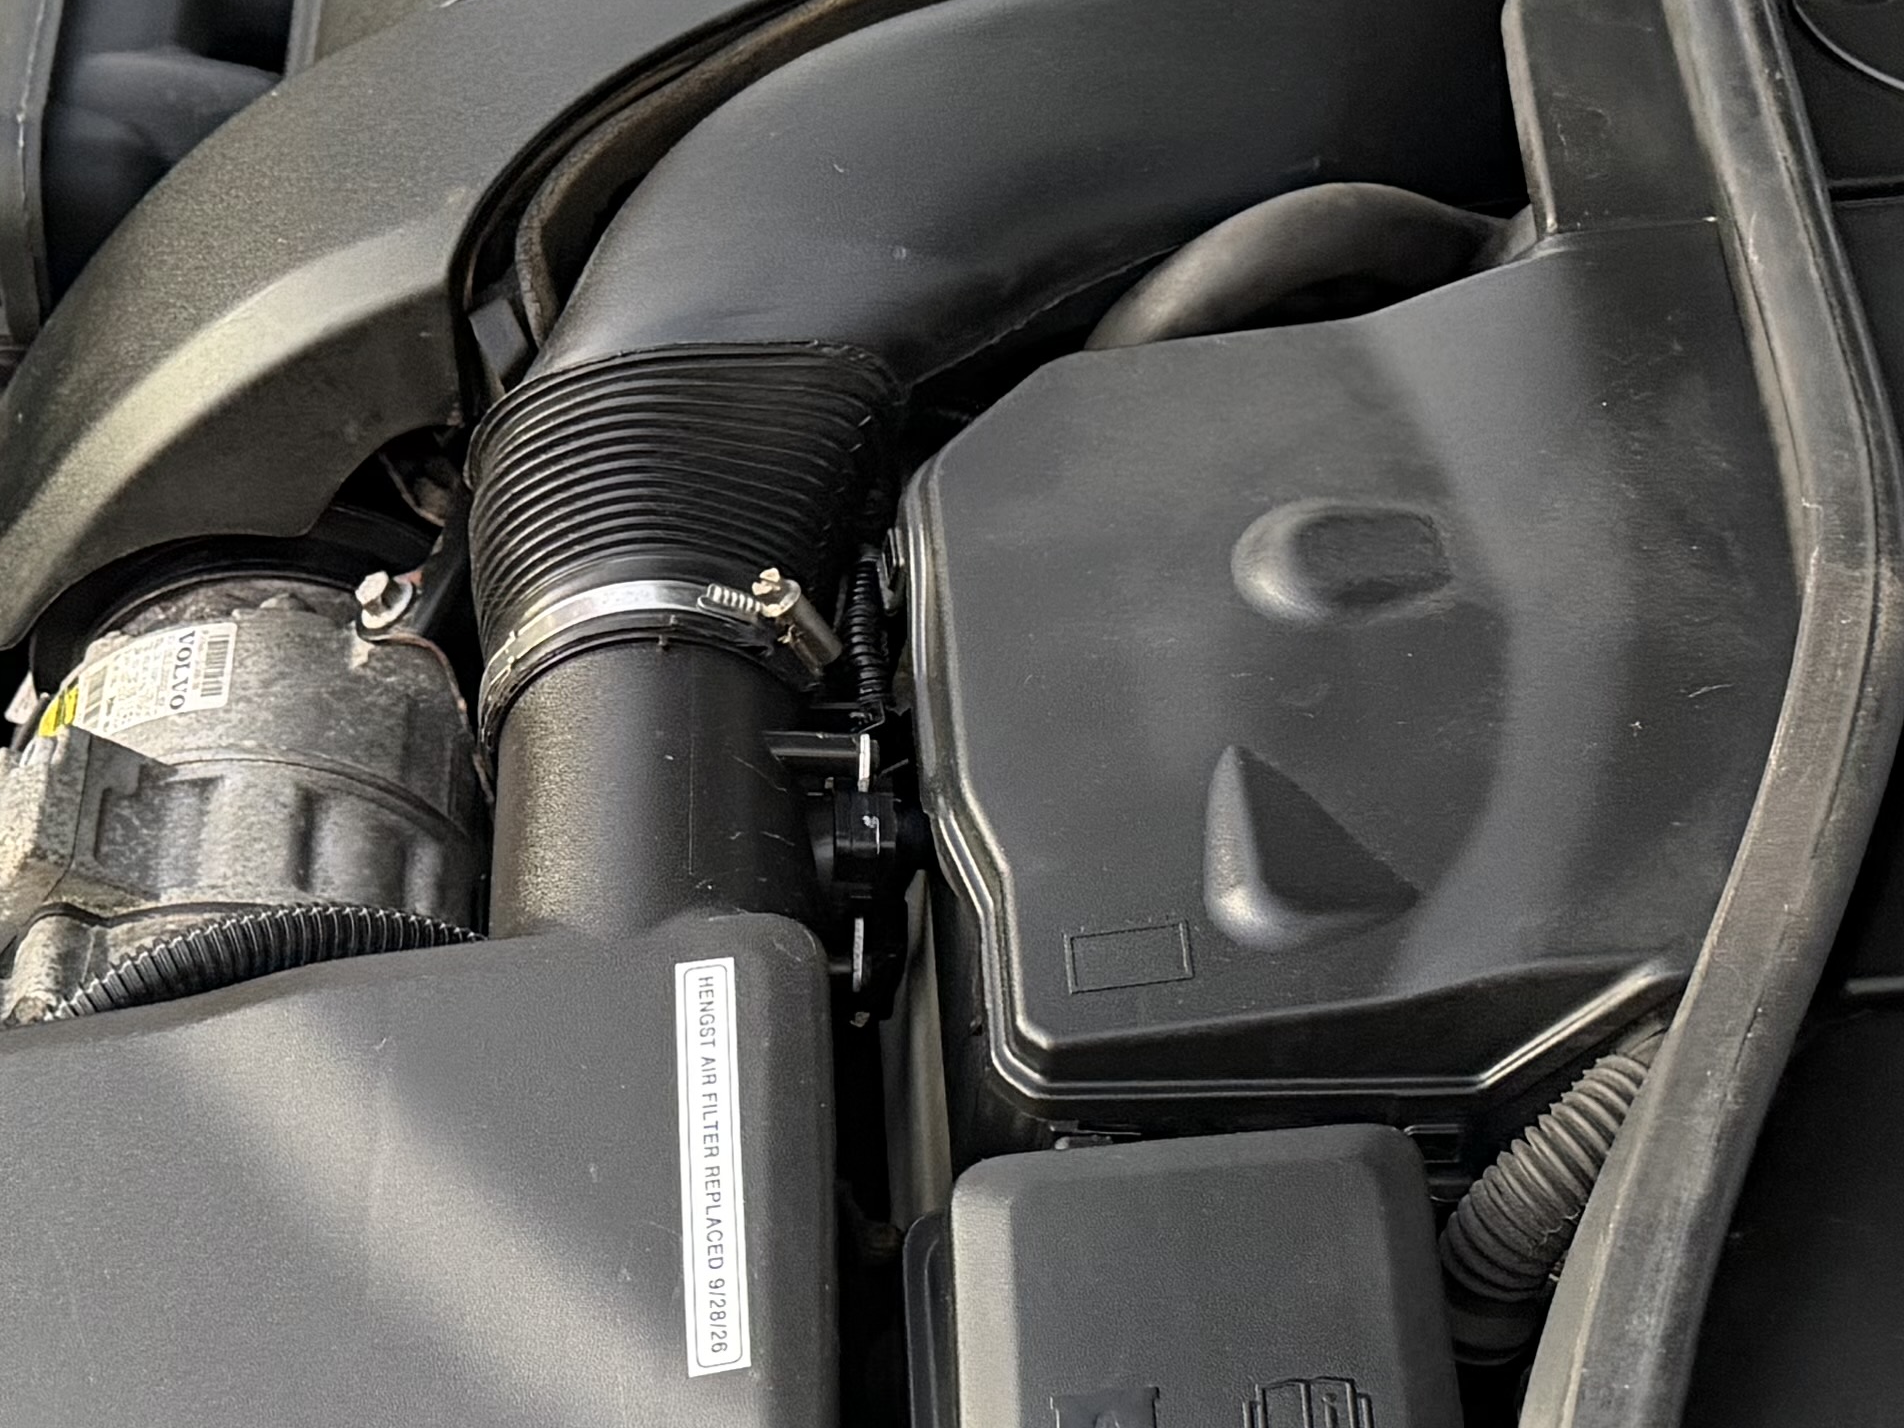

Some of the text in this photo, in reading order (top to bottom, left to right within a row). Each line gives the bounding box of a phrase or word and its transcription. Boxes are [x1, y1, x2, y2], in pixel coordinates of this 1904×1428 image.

[170, 630, 197, 710] VOLVO
[698, 975, 729, 1354] HENGST AIR FILTER REPLACED 9/28/26
